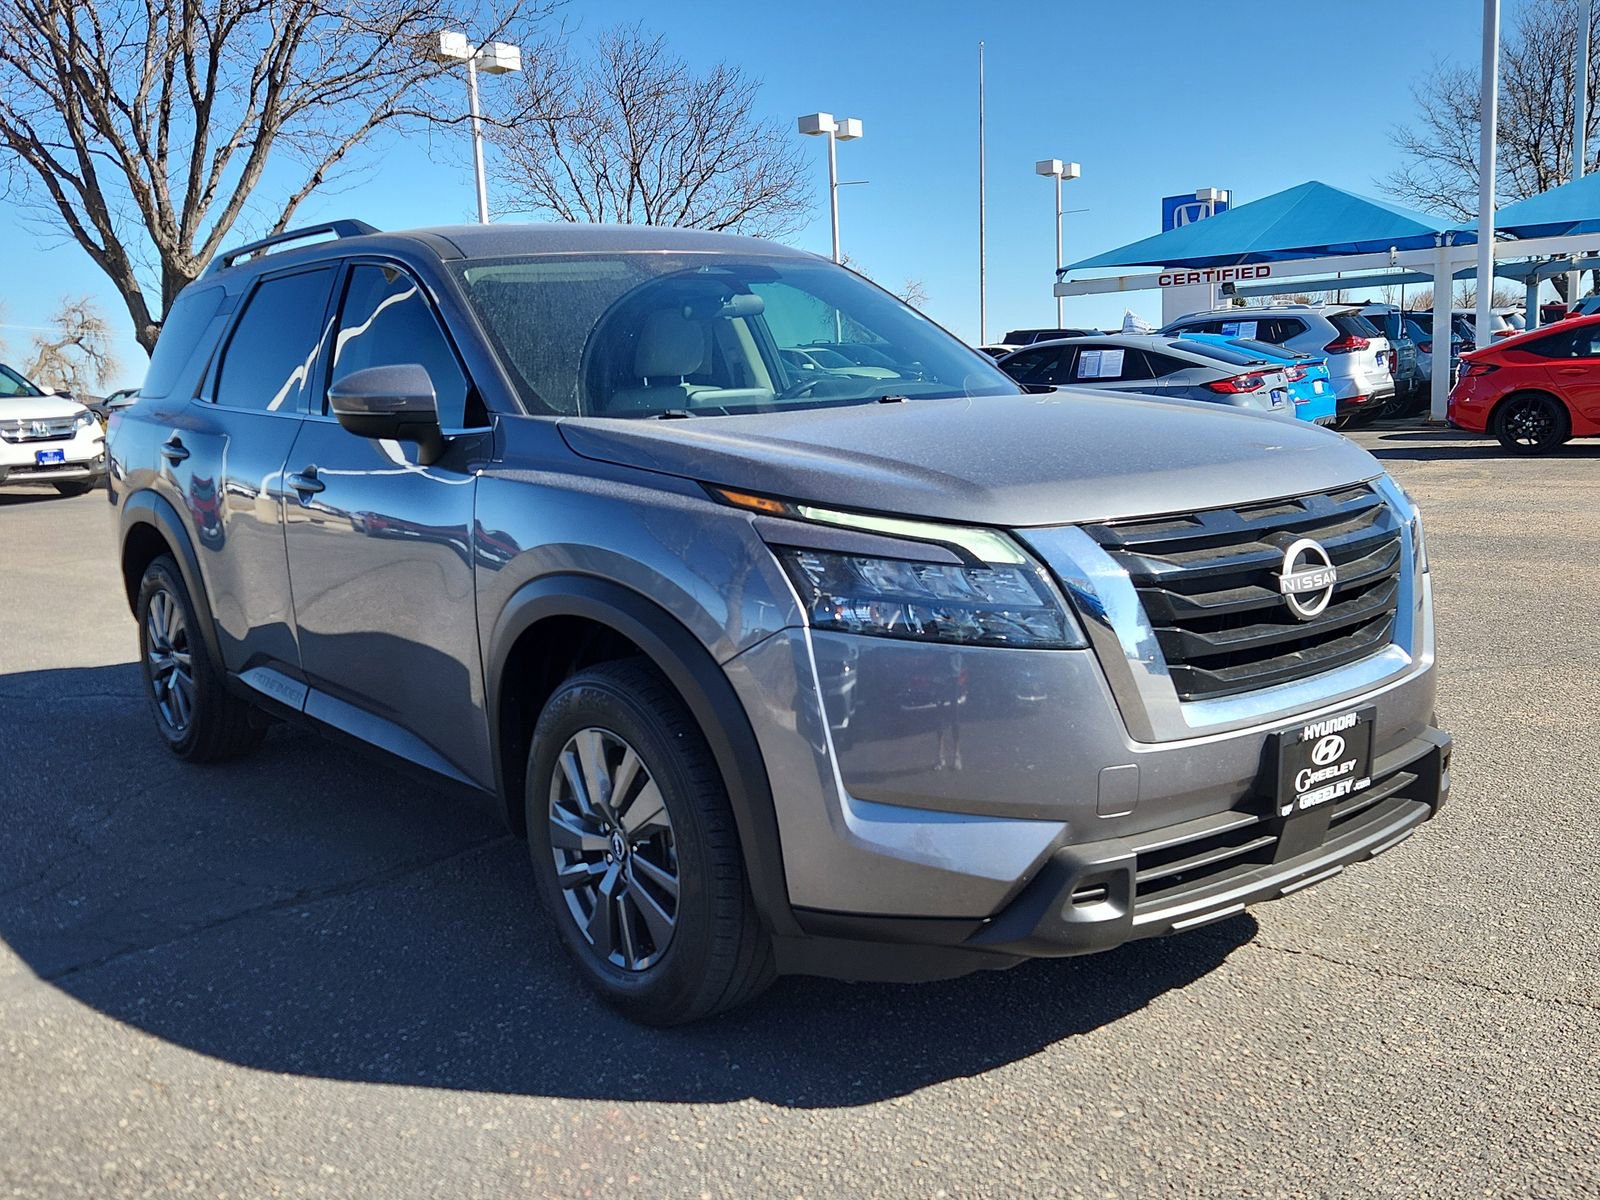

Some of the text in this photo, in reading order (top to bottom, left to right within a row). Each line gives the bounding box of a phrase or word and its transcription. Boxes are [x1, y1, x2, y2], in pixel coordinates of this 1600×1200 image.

[1158, 265, 1271, 286] CERTIFIED
[1283, 570, 1336, 592] NISSAN
[1303, 712, 1357, 740] HYUNDAI
[1295, 759, 1357, 792] GREELEY
